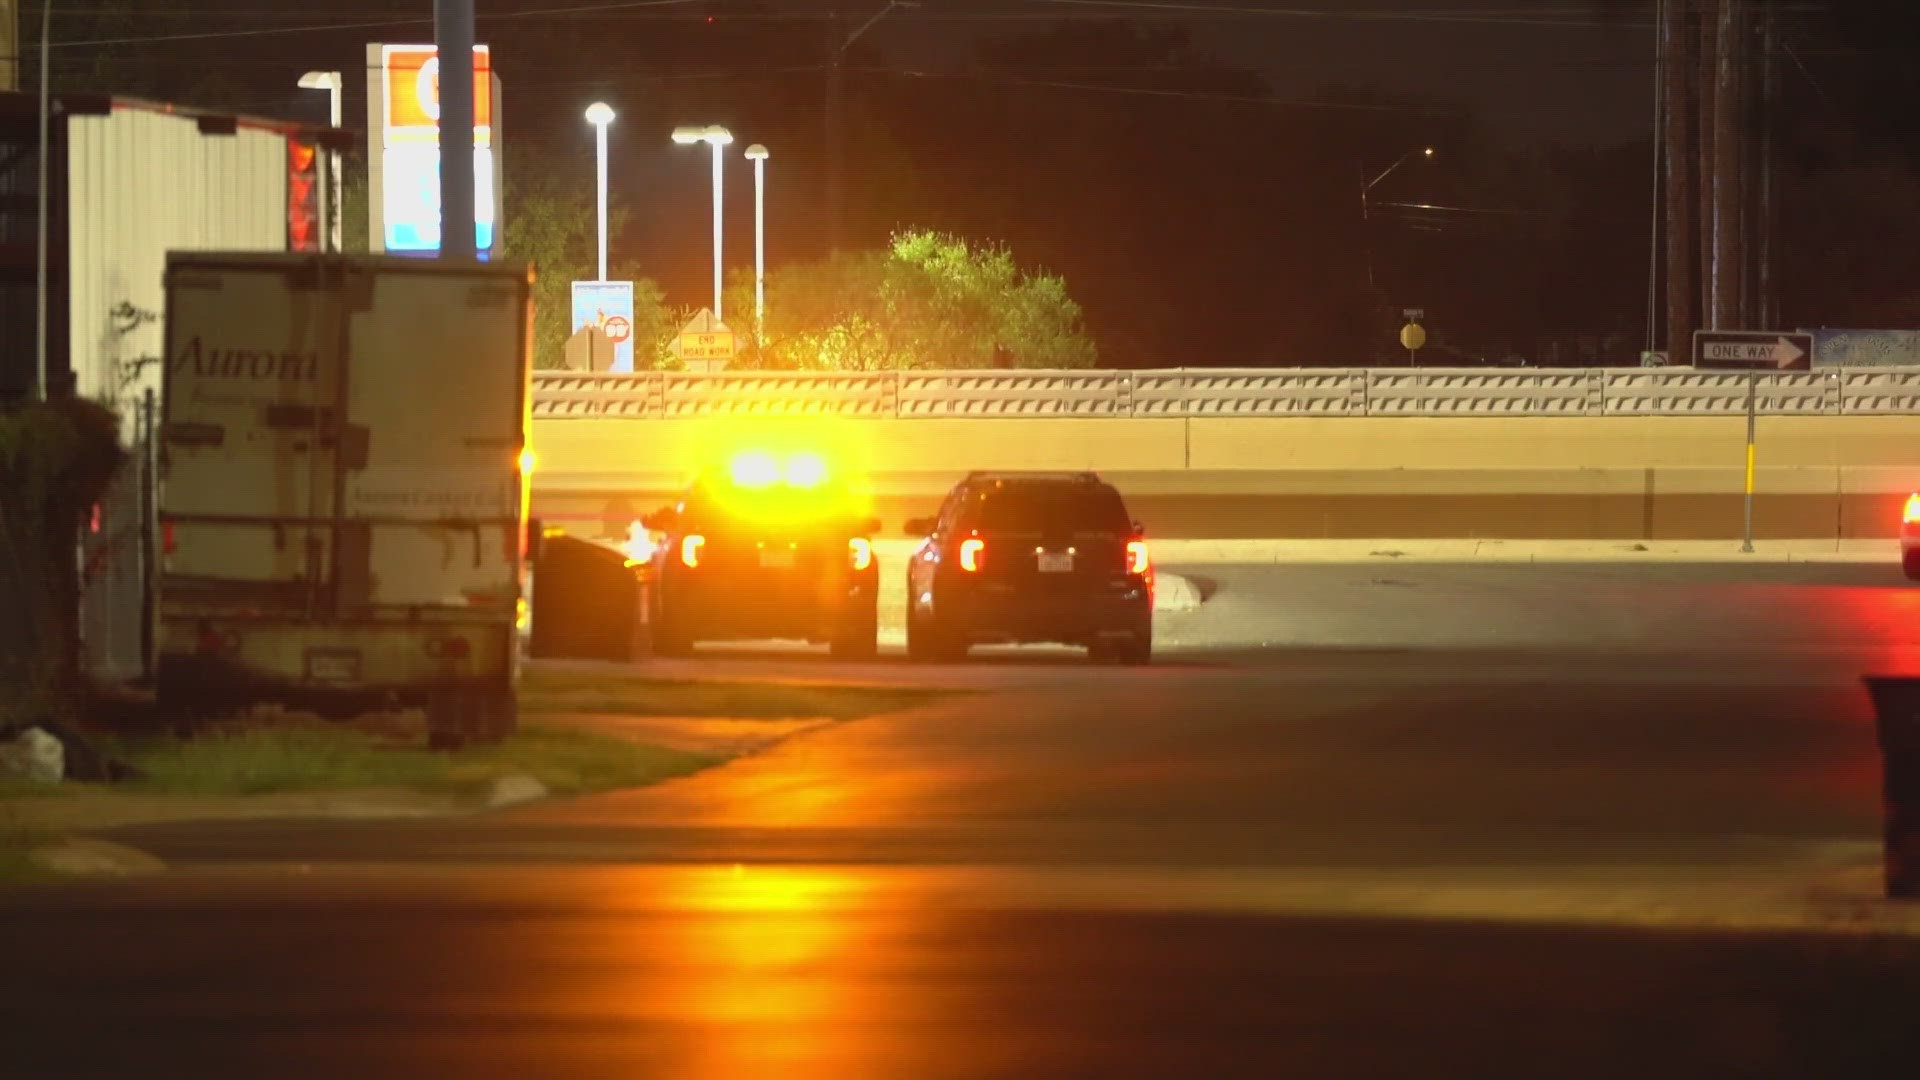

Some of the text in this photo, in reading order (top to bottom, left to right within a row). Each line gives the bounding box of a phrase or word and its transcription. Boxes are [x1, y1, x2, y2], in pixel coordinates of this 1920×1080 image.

[698, 335, 715, 345] END
[683, 347, 730, 356] ROAD WORK
[1712, 345, 1776, 358] ONE WAY
[171, 335, 319, 381] Aurora
